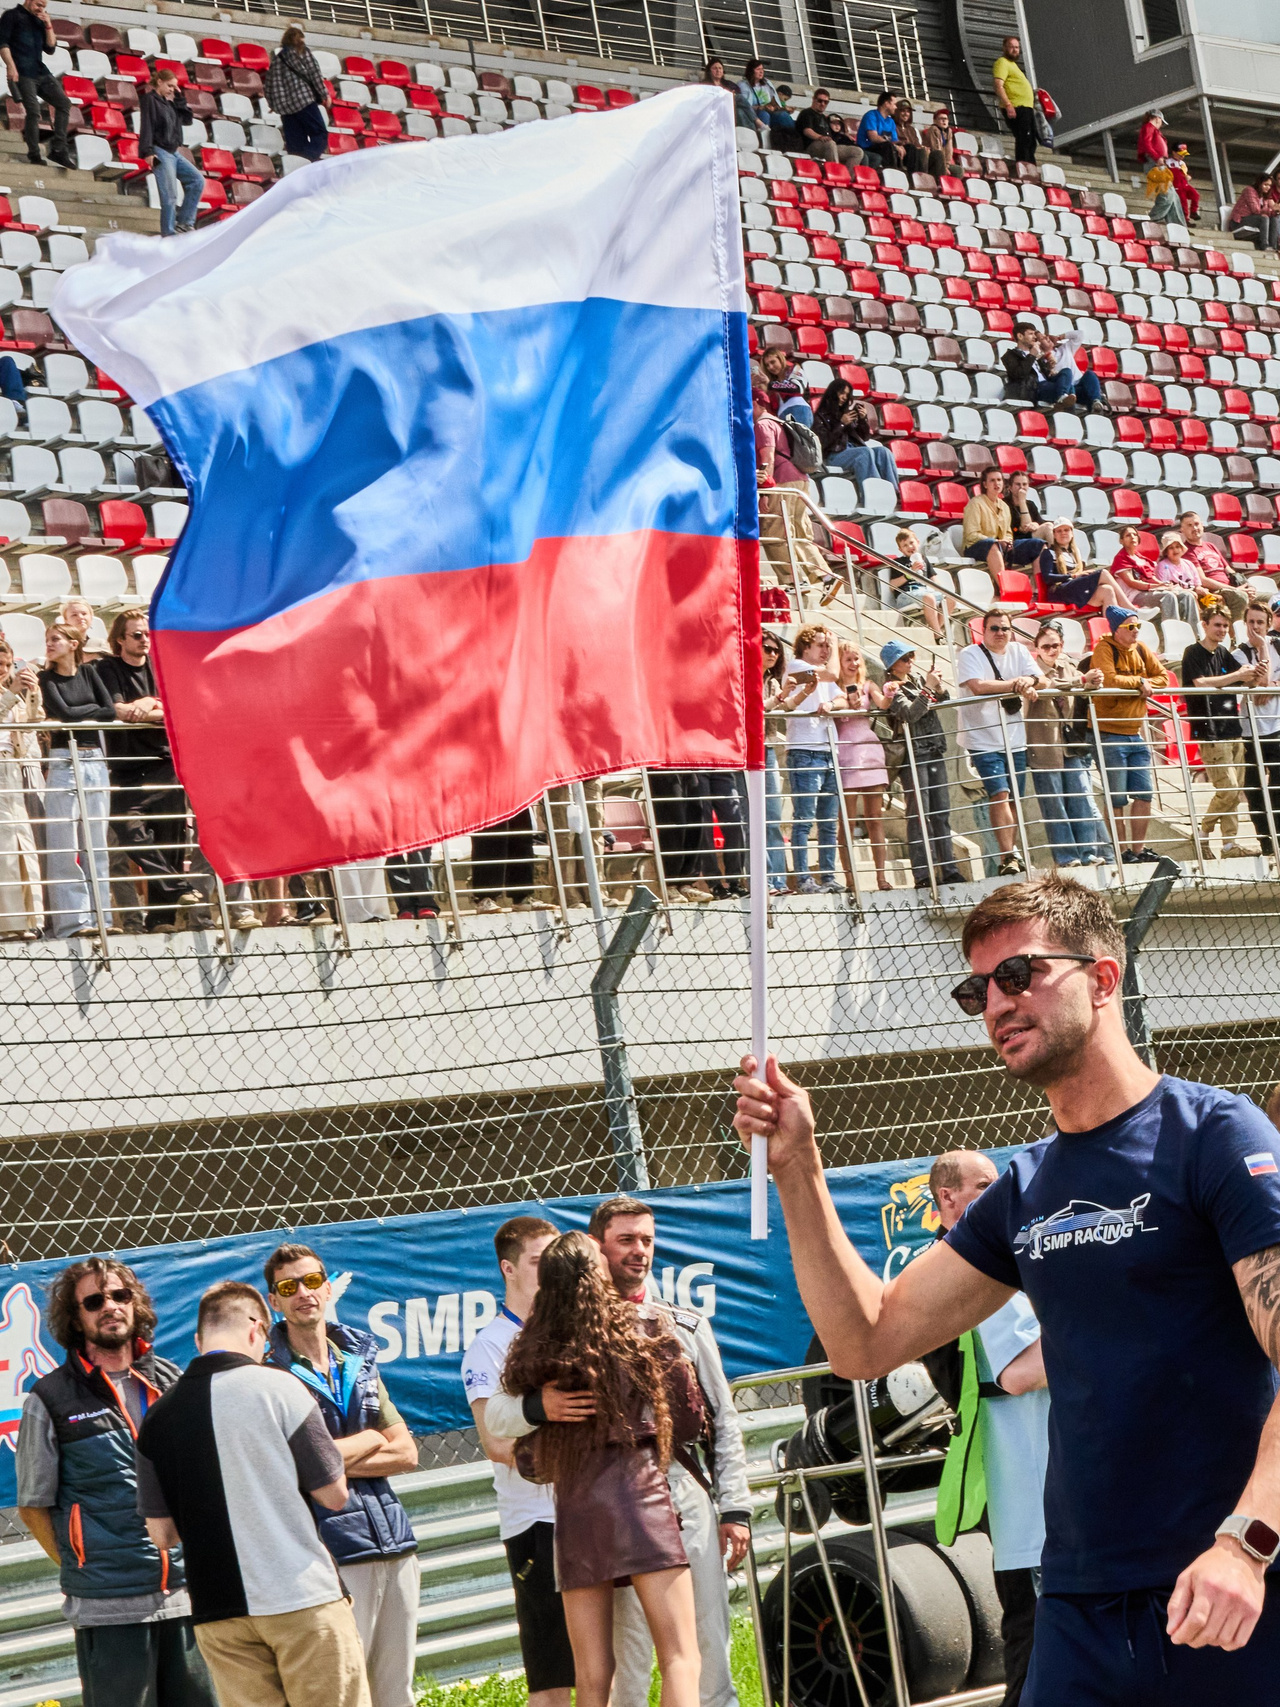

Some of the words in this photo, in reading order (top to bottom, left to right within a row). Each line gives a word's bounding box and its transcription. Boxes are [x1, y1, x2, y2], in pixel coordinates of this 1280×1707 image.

[1043, 1232, 1072, 1252] SMP
[1074, 1223, 1134, 1246] RACING
[367, 1290, 497, 1364] SMP
